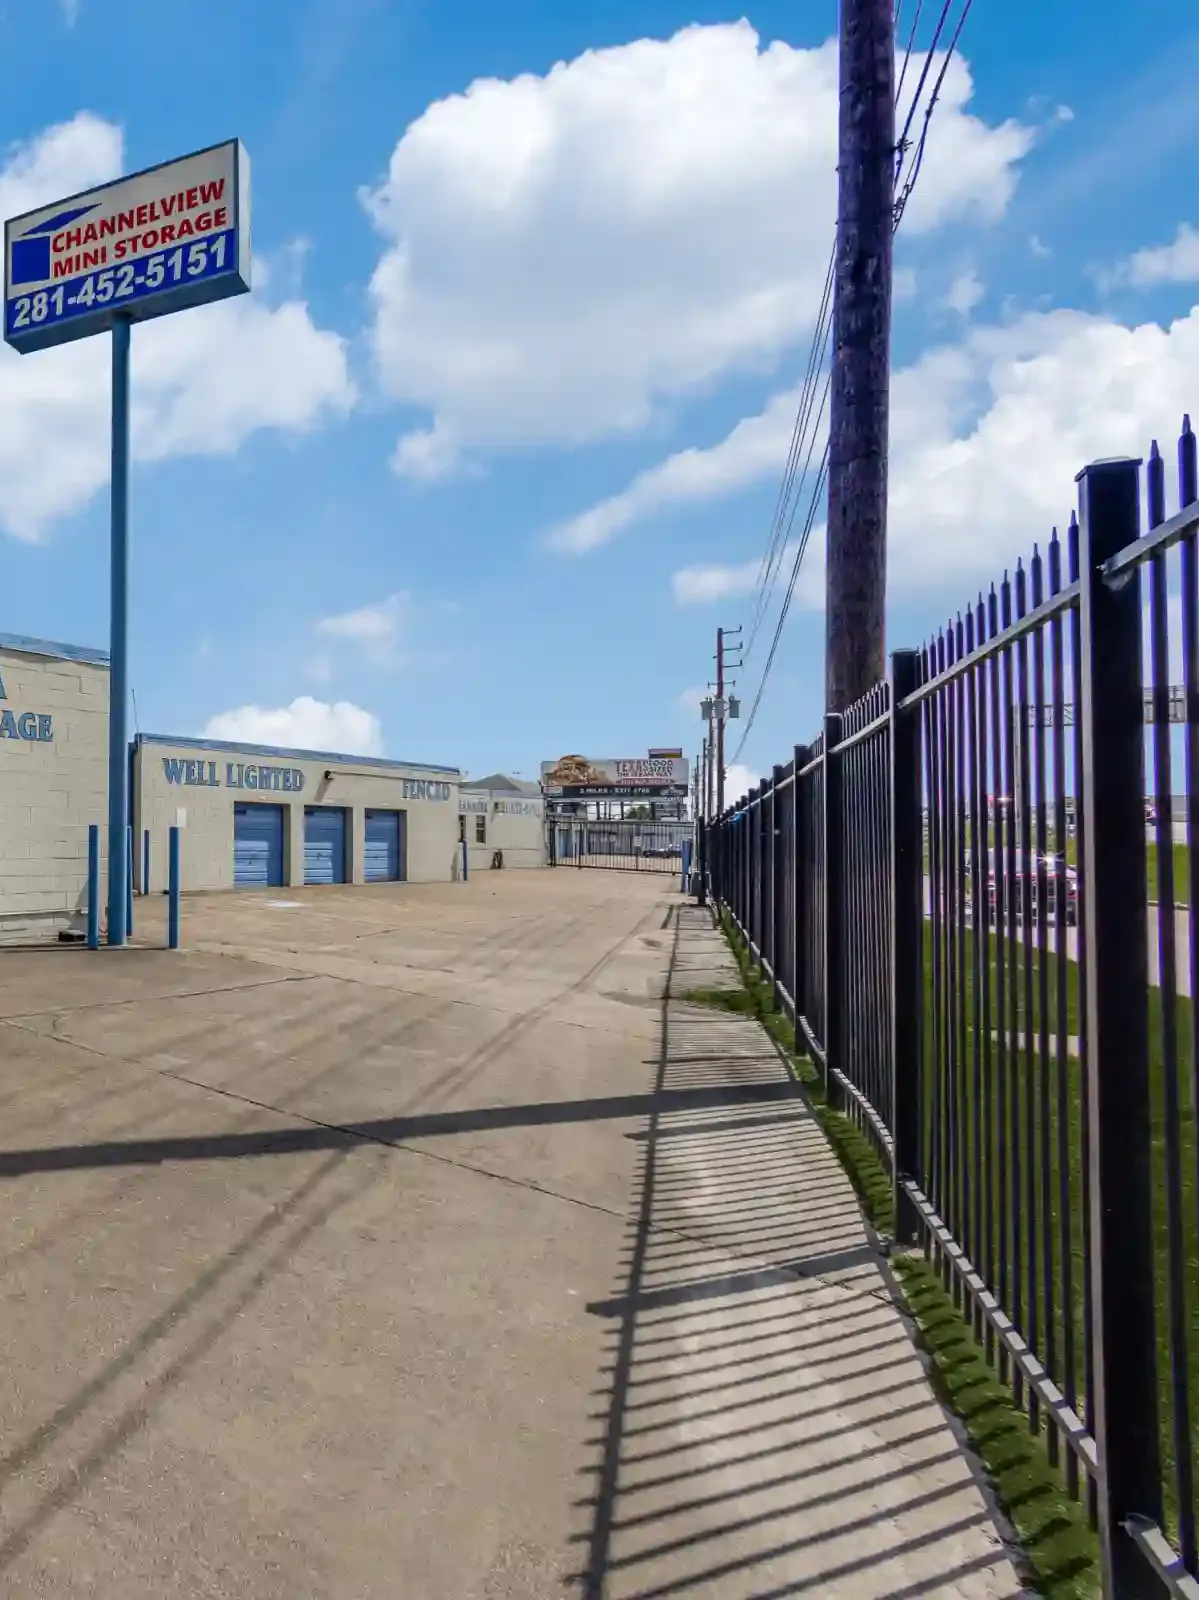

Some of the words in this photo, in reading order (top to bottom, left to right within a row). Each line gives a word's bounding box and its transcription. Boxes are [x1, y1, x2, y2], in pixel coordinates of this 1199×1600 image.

[52, 178, 225, 253] CHANNELVIEW
[53, 246, 107, 278] MINI
[114, 206, 227, 259] STORAGE
[13, 235, 226, 328] 281-452-5151
[161, 758, 219, 787] WELL
[225, 763, 305, 791] LIGHTED
[615, 760, 649, 772] TEXAS
